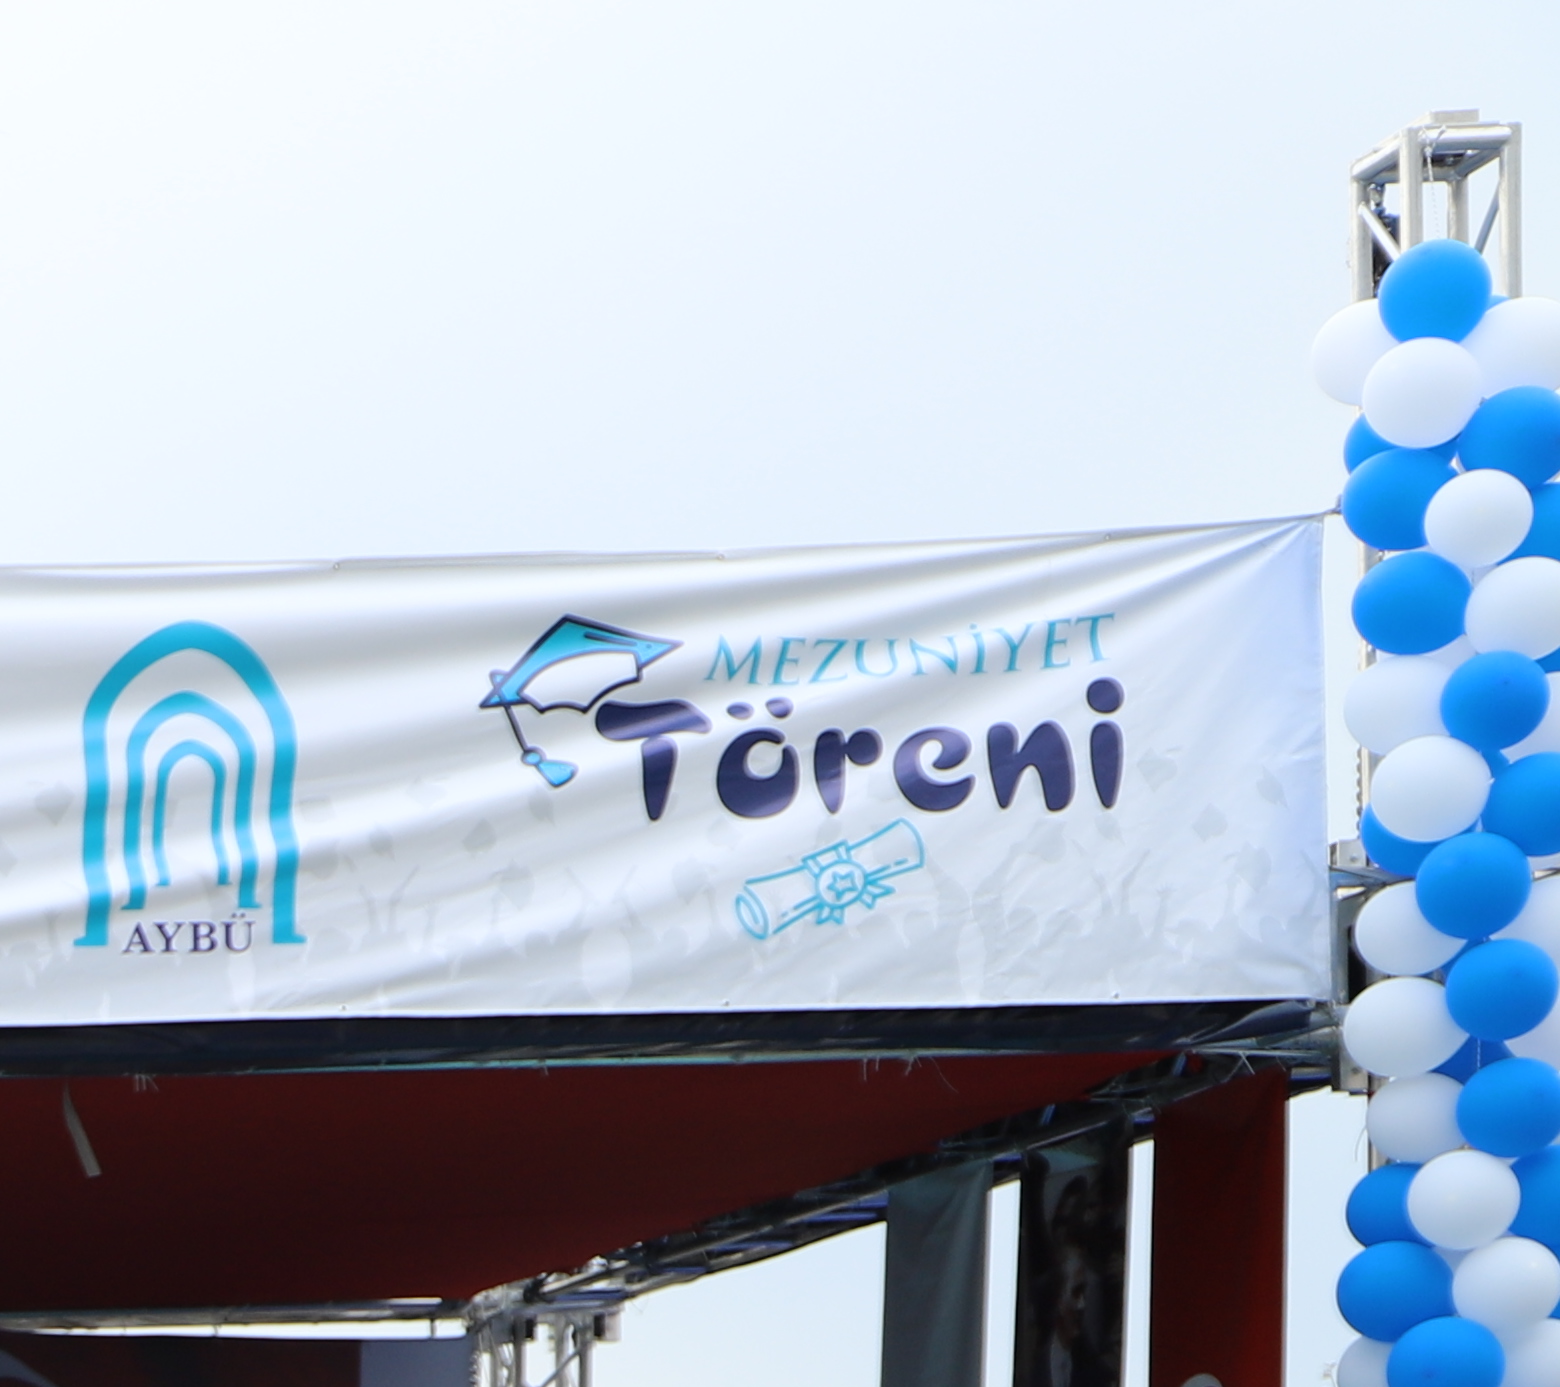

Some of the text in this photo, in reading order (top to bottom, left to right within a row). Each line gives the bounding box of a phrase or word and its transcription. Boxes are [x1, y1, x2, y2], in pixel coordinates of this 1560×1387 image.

[704, 612, 1119, 688] MEZUNİYET
[593, 677, 1125, 823] Töreni
[121, 911, 257, 956] AYBÜ
